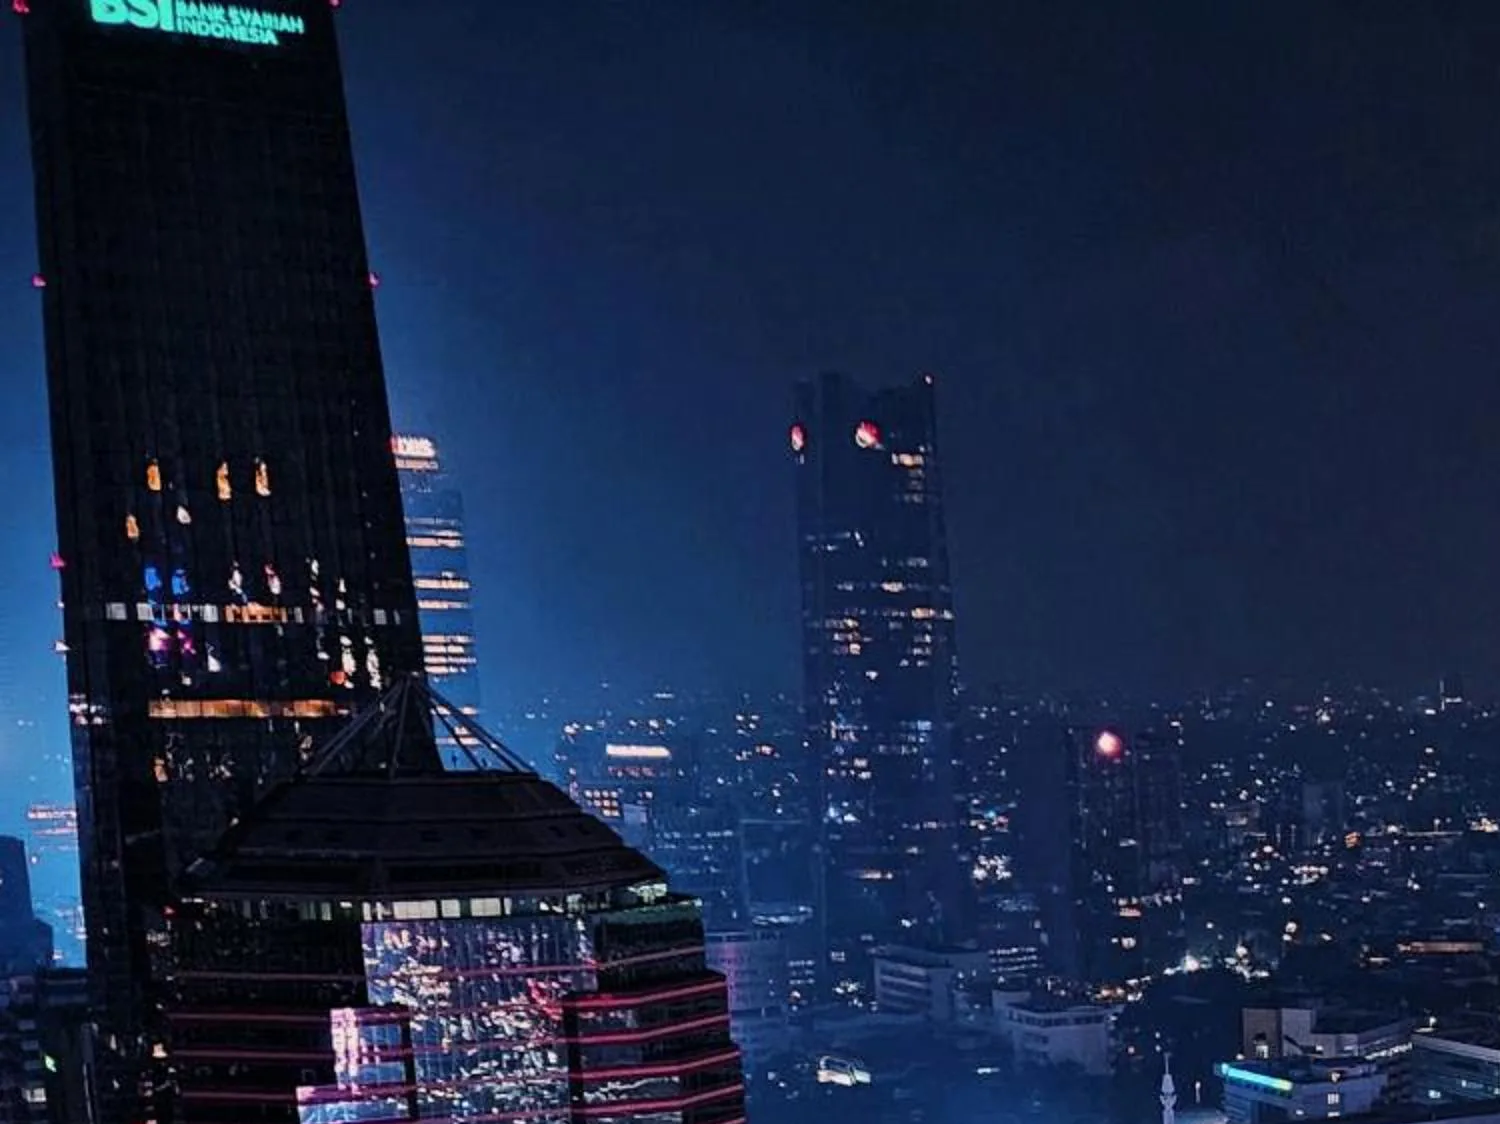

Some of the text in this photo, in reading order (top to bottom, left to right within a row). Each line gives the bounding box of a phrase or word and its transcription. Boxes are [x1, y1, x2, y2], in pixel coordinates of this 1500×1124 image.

[90, 0, 174, 31] BSI
[176, 0, 304, 34] BANK SYARIAH
[177, 18, 279, 45] INDONESIA
